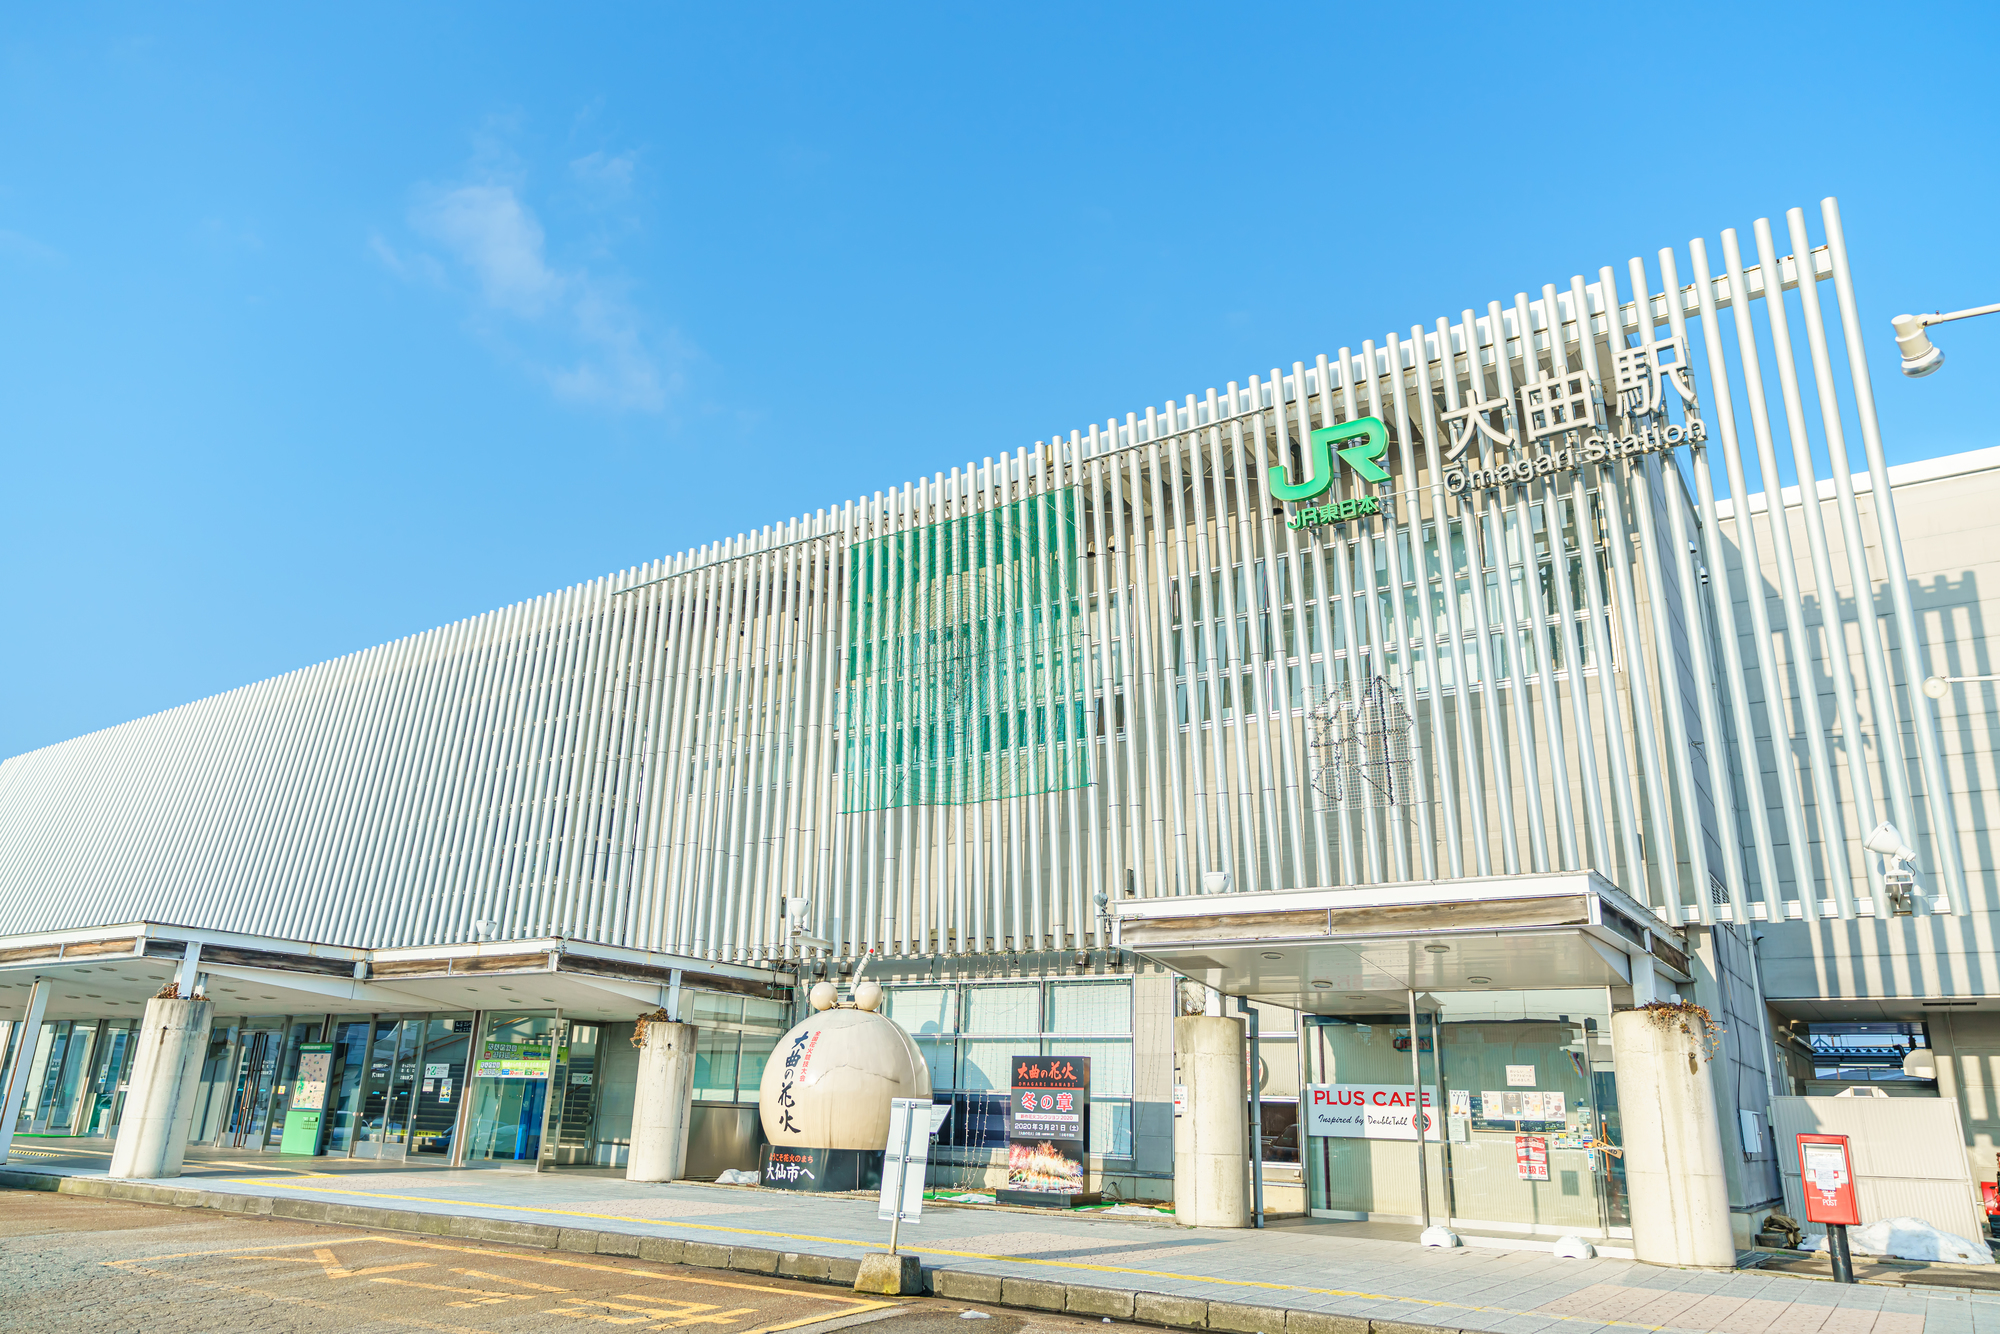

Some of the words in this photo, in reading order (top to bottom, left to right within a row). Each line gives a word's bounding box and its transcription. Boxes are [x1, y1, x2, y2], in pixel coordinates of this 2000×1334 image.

[1440, 336, 1696, 462] 大曲駅
[1583, 418, 1708, 464] Station
[1268, 416, 1393, 502] JR
[1287, 494, 1380, 531] JR東日本
[1393, 1038, 1431, 1050] OPN
[799, 1030, 822, 1082] 全国花火競技大会
[1017, 1061, 1077, 1080] 大曲の花火
[777, 1030, 809, 1134] 大曲の花火
[1021, 1091, 1073, 1112] 冬の章
[1313, 1090, 1366, 1106] PLUS
[1372, 1091, 1431, 1107] CAFE
[1318, 1113, 1352, 1125] Inspired
[1354, 1114, 1364, 1126] by
[769, 1152, 814, 1164] ようこそ花火のまち
[766, 1162, 815, 1183] 大仙市へ
[1518, 1165, 1547, 1176] 取扱店
[1822, 1198, 1837, 1206] POST
